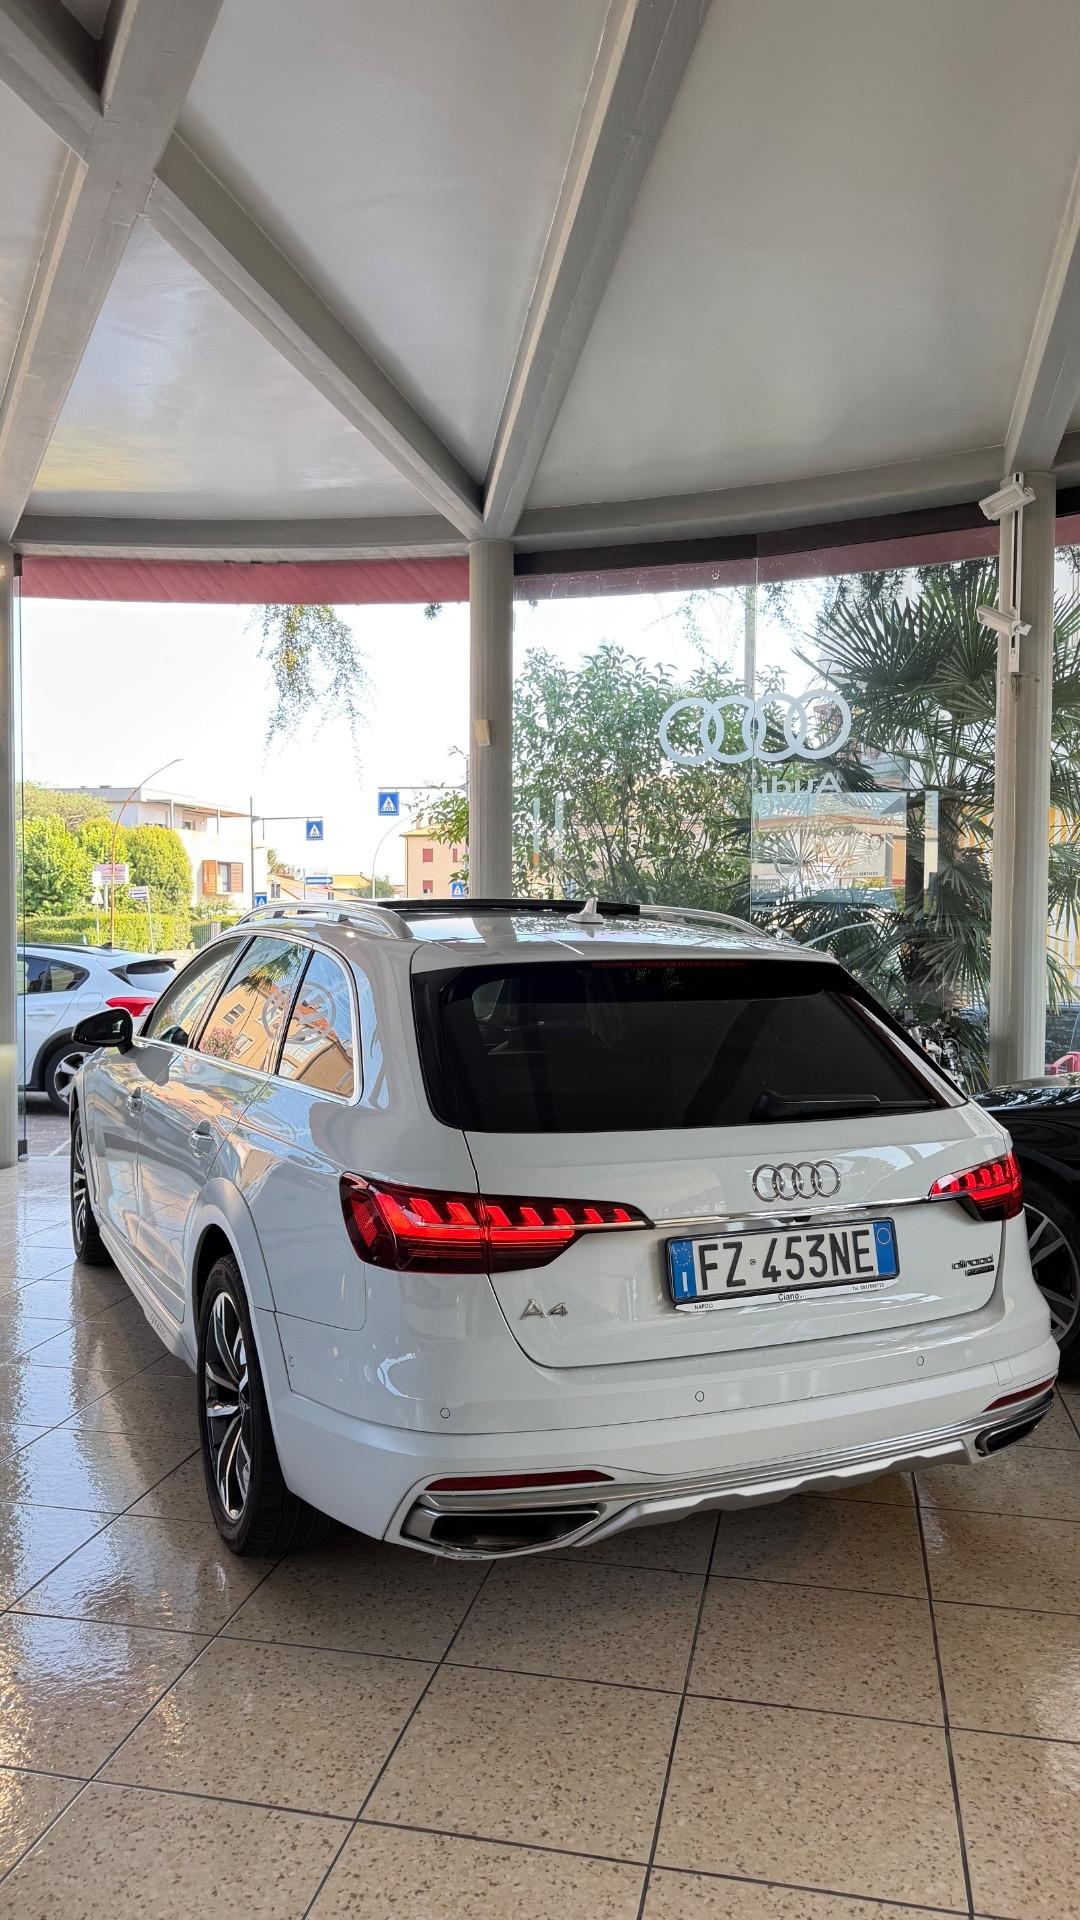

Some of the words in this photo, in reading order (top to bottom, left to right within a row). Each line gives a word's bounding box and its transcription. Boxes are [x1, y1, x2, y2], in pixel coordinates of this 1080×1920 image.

[698, 1241, 746, 1290] FZ
[762, 1229, 874, 1282] 453NE
[778, 1293, 800, 1301] Ciano
[519, 1299, 568, 1320] A4
